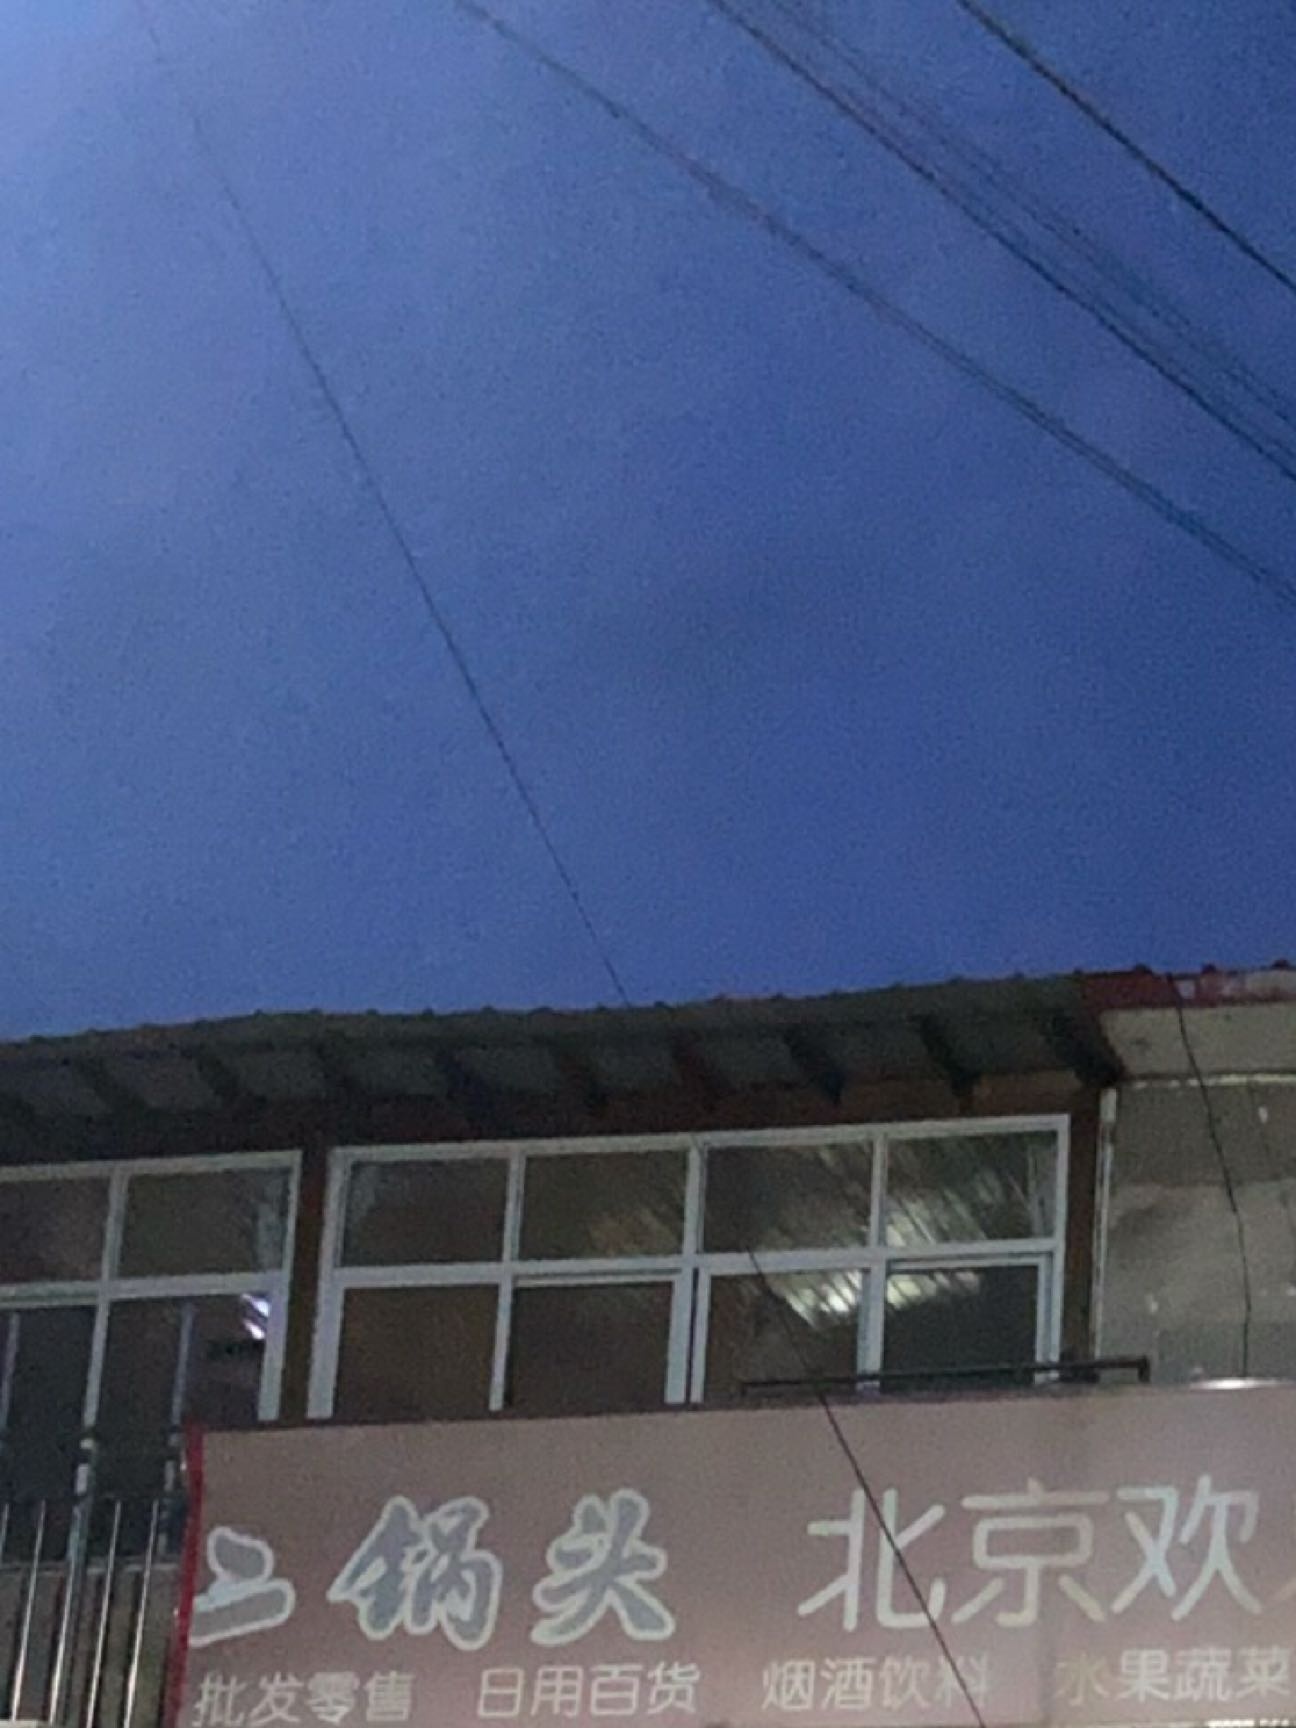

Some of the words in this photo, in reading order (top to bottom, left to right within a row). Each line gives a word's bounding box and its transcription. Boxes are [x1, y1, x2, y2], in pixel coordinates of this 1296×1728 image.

[192, 1670, 417, 1727] 批发零售
[478, 1661, 702, 1720] 日用百货
[761, 1653, 988, 1711] 烟酒饮料
[1056, 1645, 1294, 1706] 水果蔬菜
